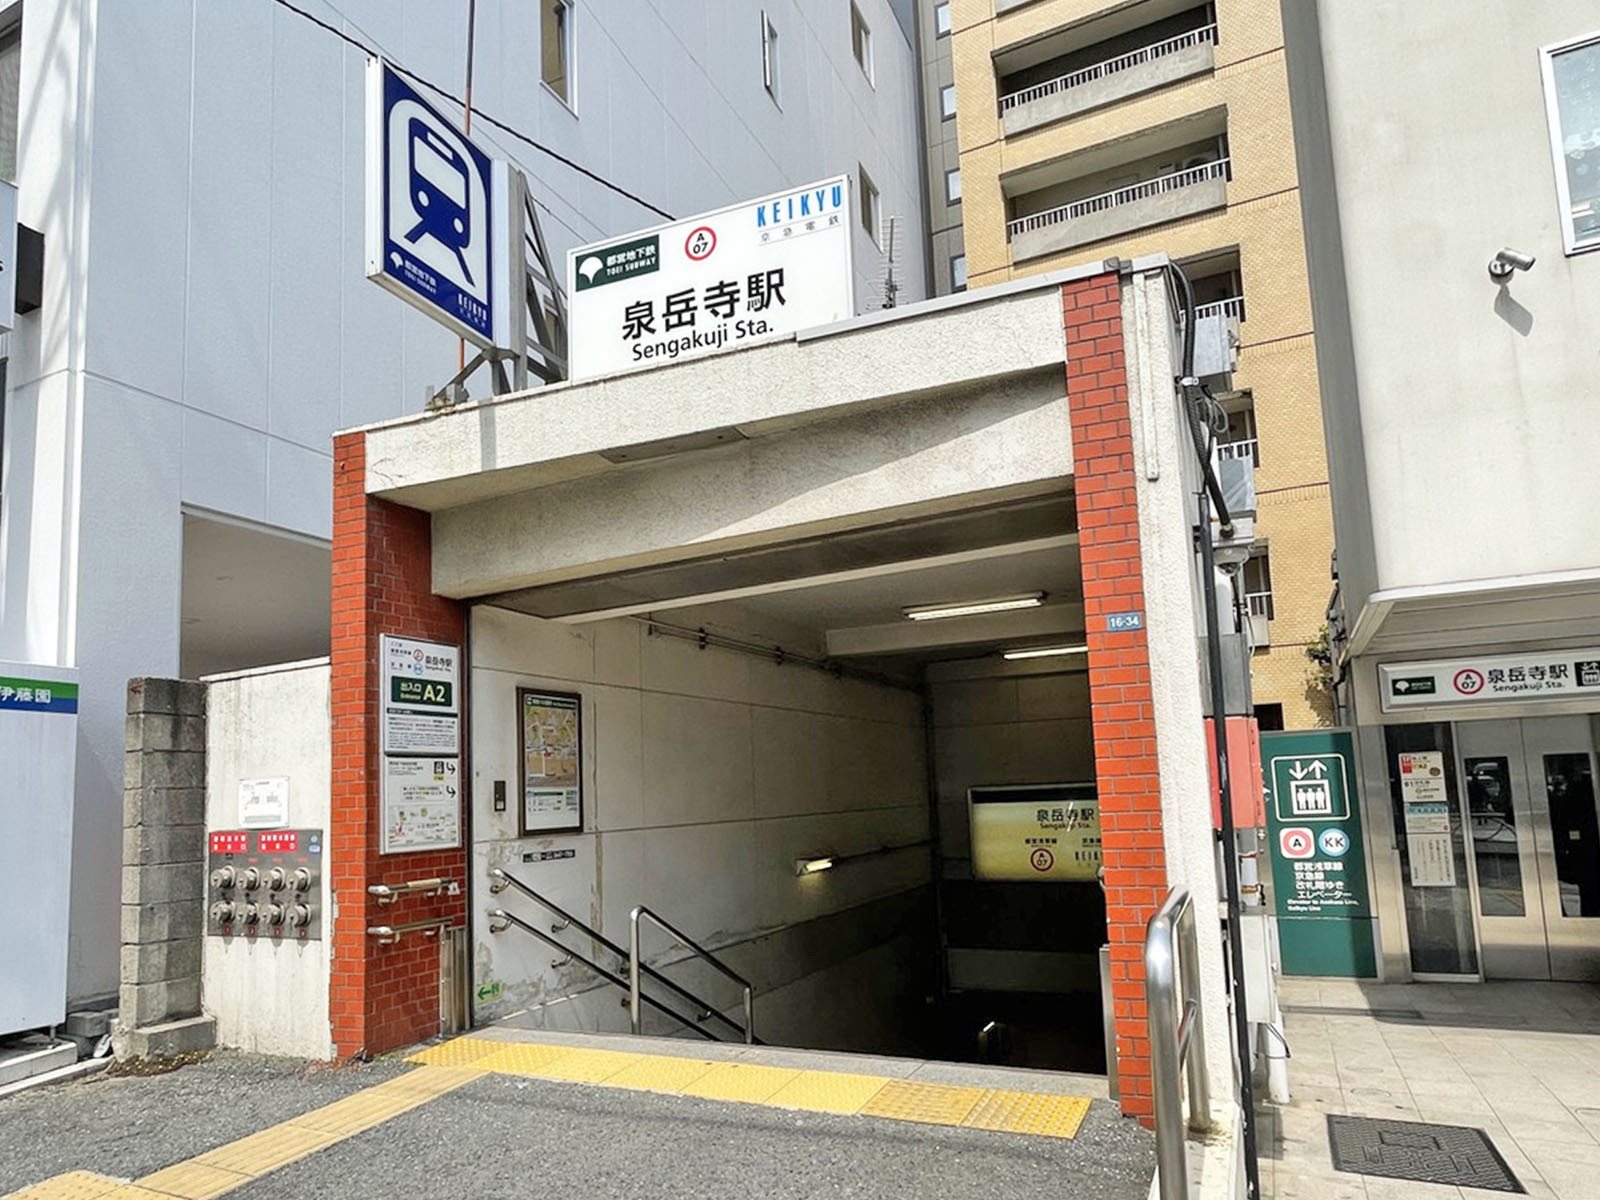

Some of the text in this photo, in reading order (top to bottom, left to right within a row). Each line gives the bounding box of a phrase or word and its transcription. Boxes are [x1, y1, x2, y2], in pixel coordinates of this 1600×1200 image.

[757, 185, 841, 227] KEIKYU
[696, 233, 705, 242] A
[693, 242, 708, 254] 07
[607, 257, 656, 276] TOEI SUBWAY
[622, 268, 786, 341] 泉岳寺駅
[632, 320, 774, 361] Sengakuji Sta.
[1110, 616, 1139, 628] 16-34
[1464, 673, 1473, 681] A
[1488, 664, 1569, 684] 泉岳寺駅
[1461, 681, 1476, 690] 07
[1492, 680, 1565, 693] Sengakuji Sta.
[0, 686, 51, 703] 伊藤園
[423, 684, 446, 702] A2
[1293, 838, 1302, 847] A
[1324, 837, 1344, 847] KK
[1297, 891, 1352, 899] エレベーター
